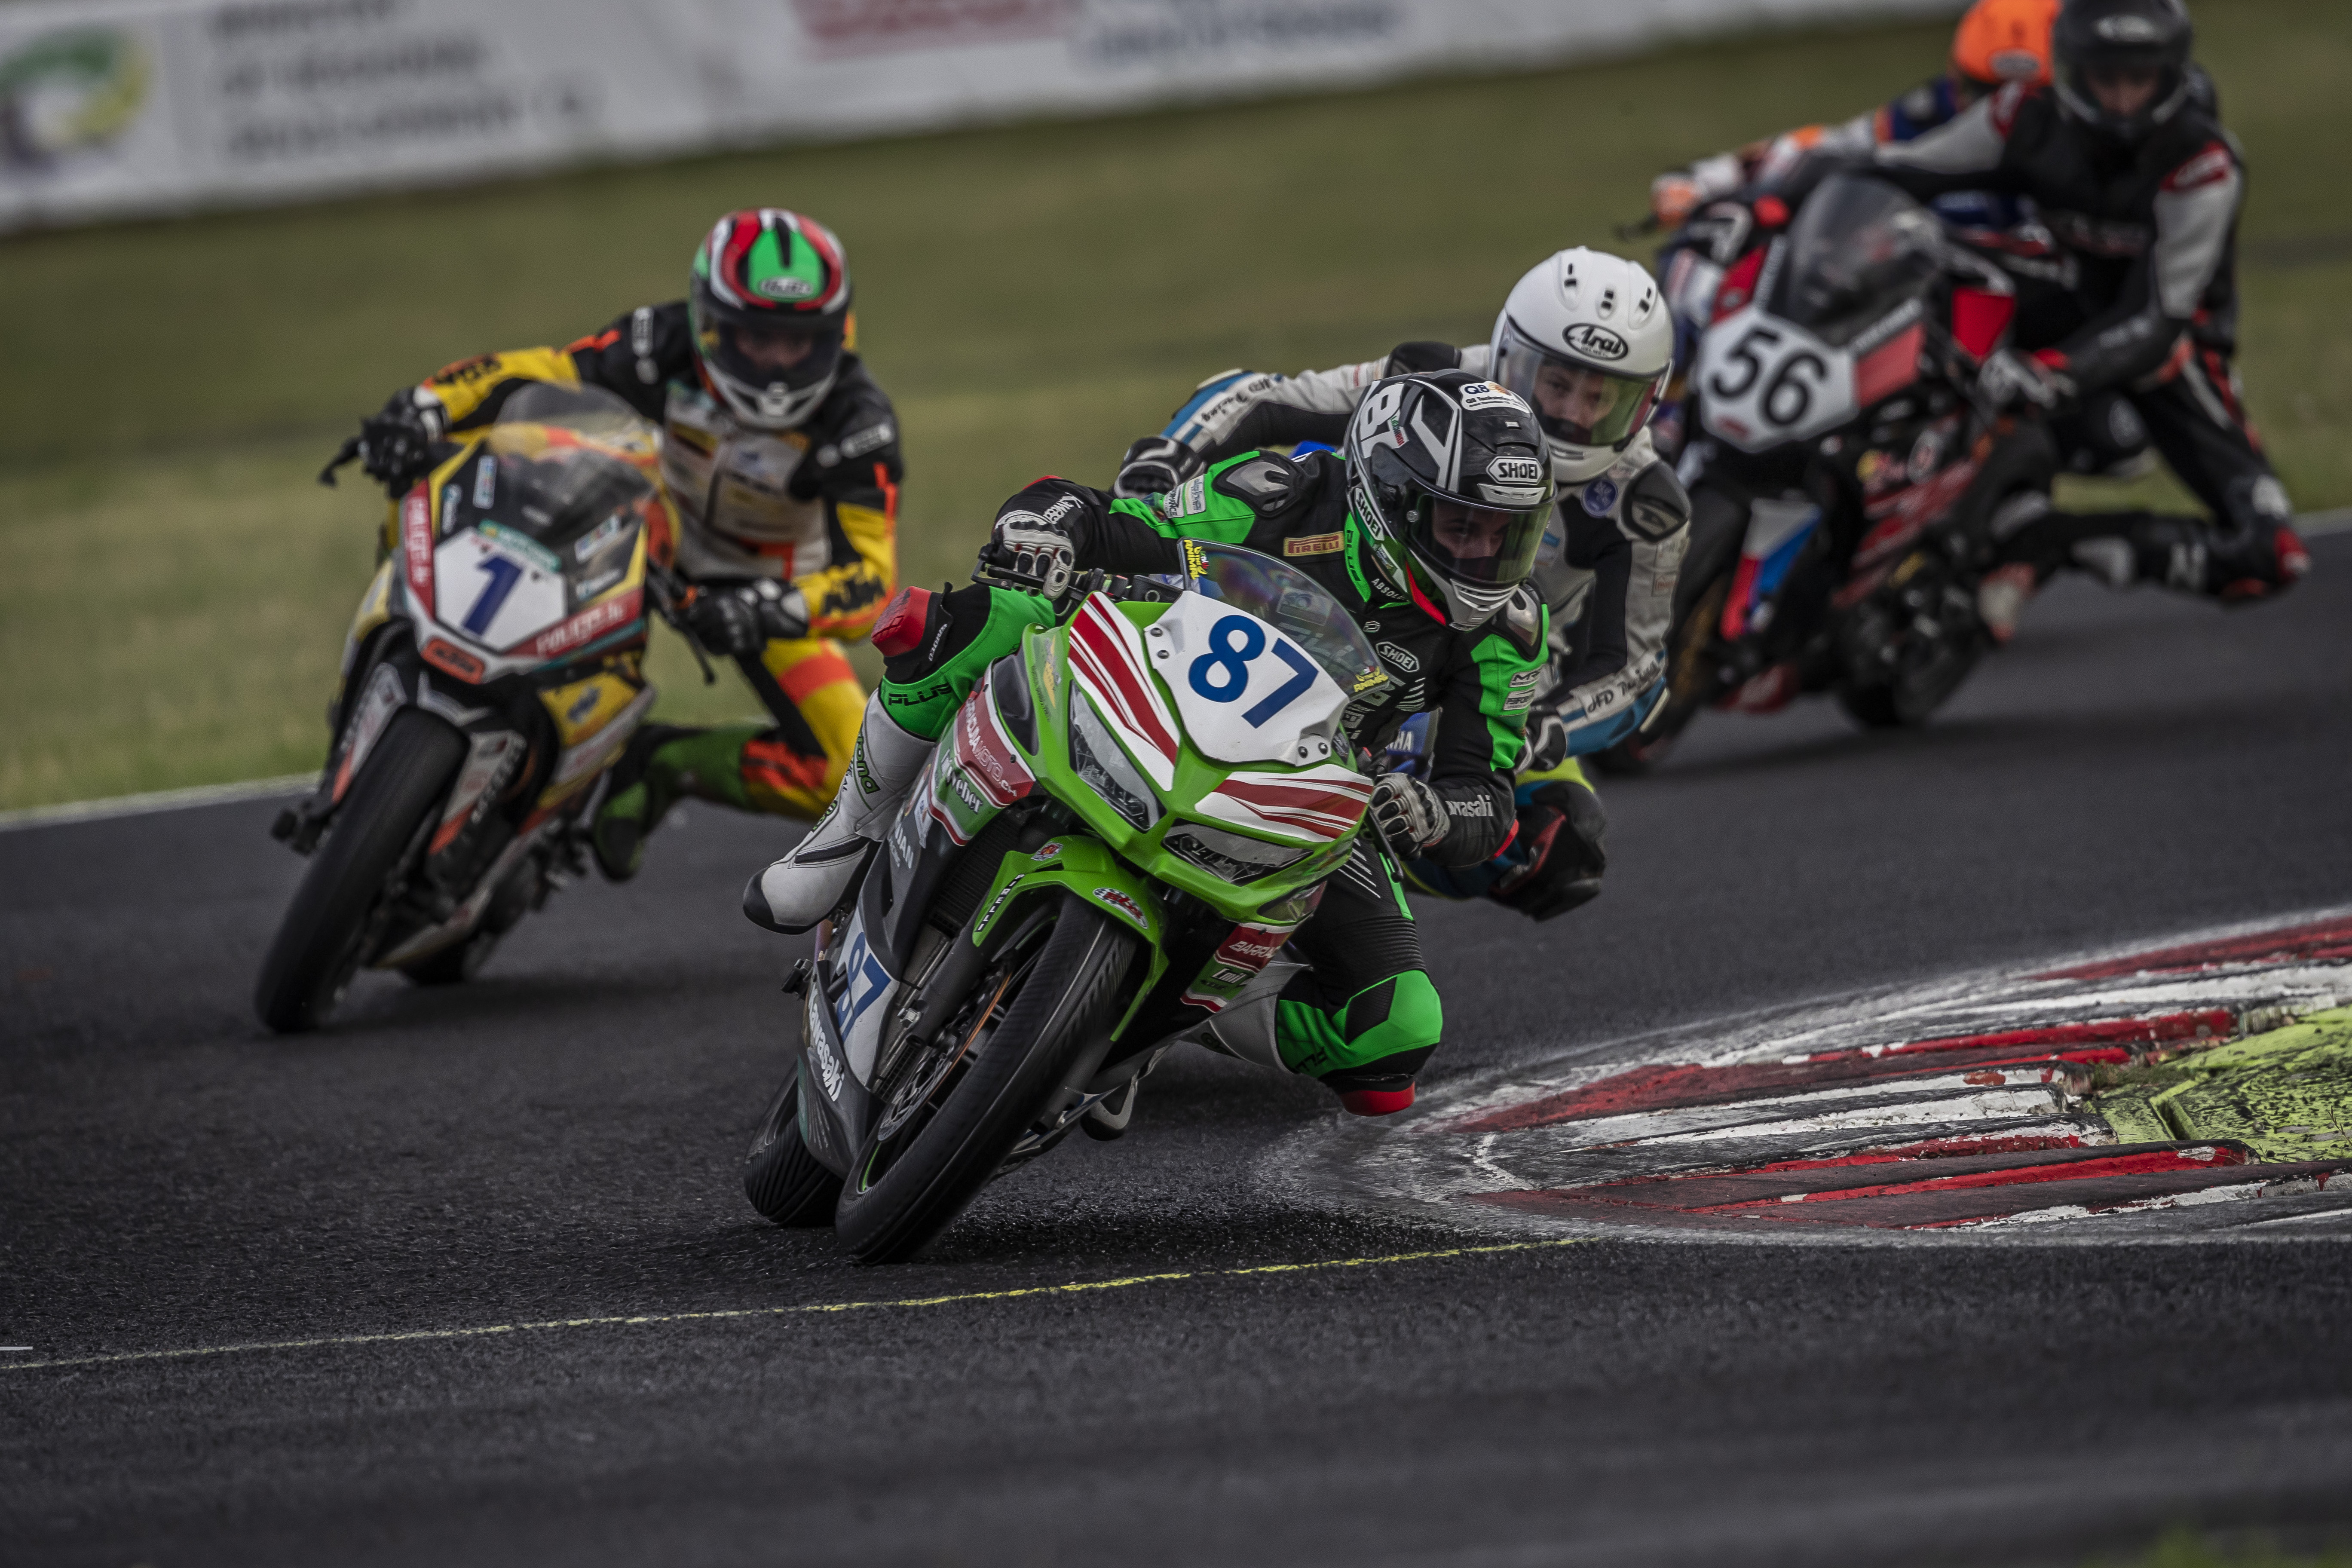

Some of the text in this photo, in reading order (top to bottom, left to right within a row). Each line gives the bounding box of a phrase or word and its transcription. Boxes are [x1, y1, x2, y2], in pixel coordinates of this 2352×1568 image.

[1464, 384, 1490, 394] Q8
[1709, 325, 1828, 427] 56
[1498, 462, 1539, 480] SHOEI
[1043, 492, 1084, 524] Kawasa
[1356, 492, 1381, 537] SHOEI
[1184, 539, 1200, 580] ANIMAL
[1288, 535, 1340, 554] PIRELLI
[463, 557, 523, 637] 1
[1188, 615, 1319, 729] 87
[1380, 645, 1415, 670] SHOEI
[888, 683, 952, 707] PLUS
[1446, 795, 1494, 817] wasaki
[974, 874, 1025, 933] PIRELLI
